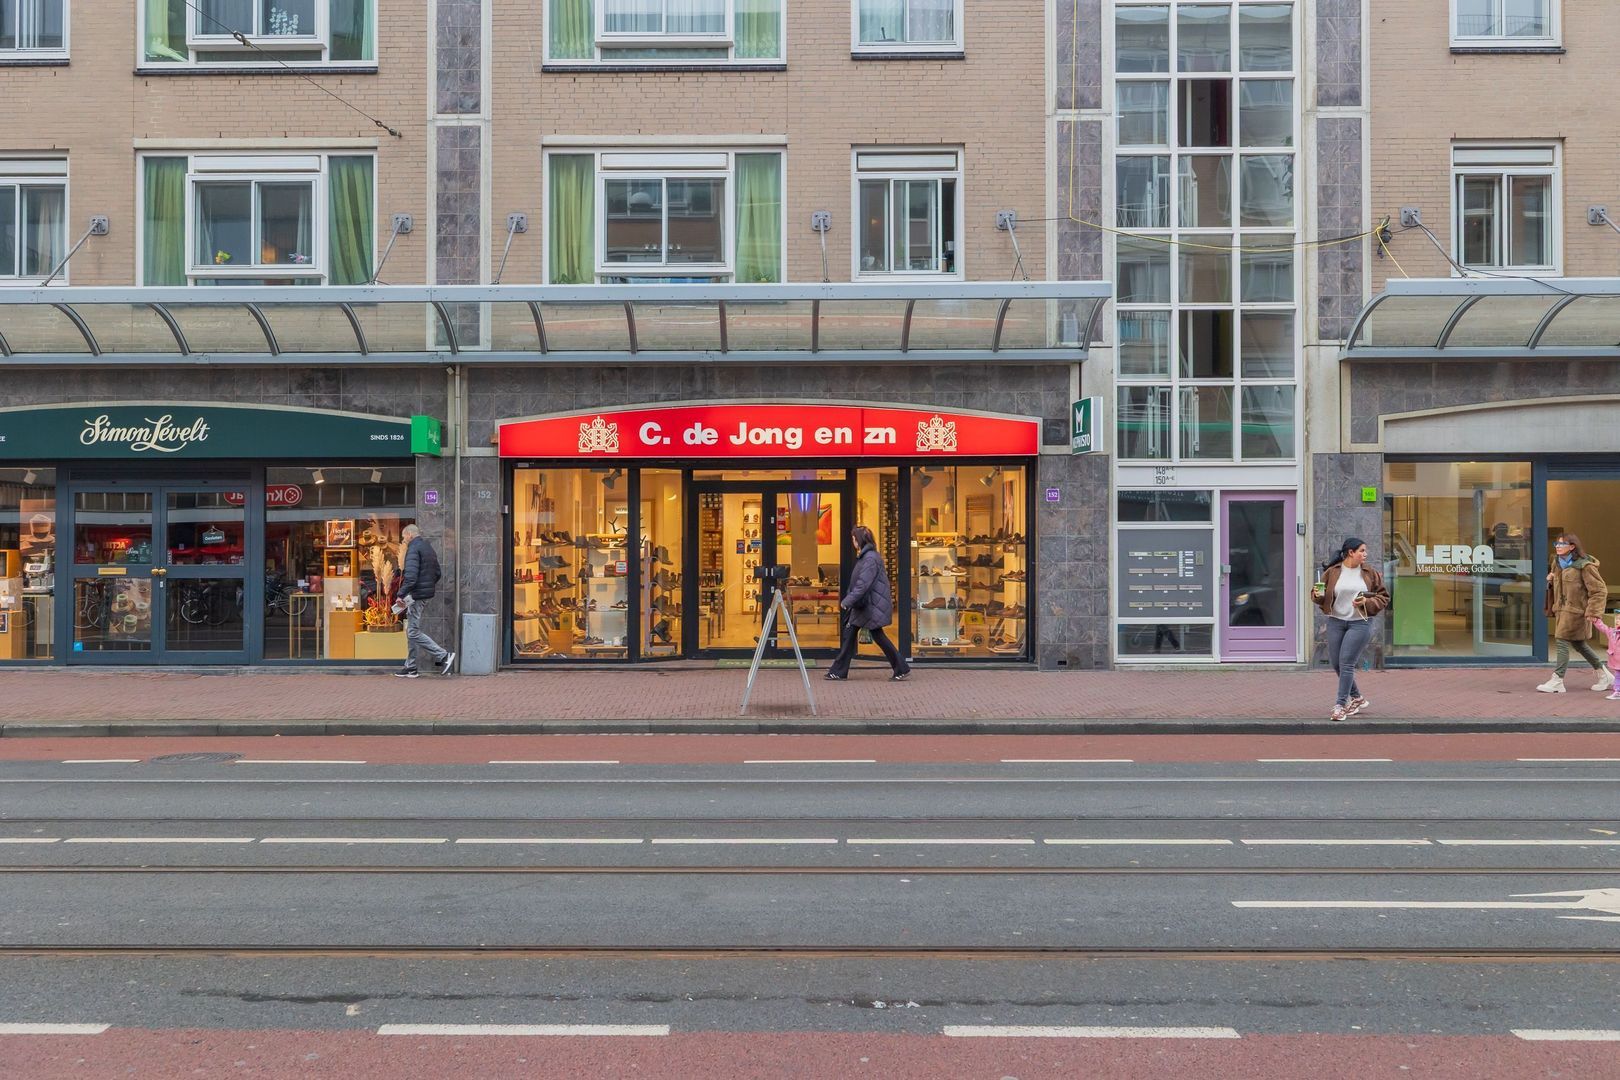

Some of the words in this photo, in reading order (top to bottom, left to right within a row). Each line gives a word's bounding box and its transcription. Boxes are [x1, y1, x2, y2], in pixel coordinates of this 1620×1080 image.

[80, 414, 152, 445] Simon
[131, 414, 211, 453] Lévelt
[639, 421, 671, 445] C.
[683, 422, 718, 445] de
[729, 422, 803, 450] Jong
[814, 427, 853, 445] en
[864, 427, 897, 444] zn
[477, 491, 492, 499] 152
[1416, 544, 1494, 564] LERA
[1416, 565, 1445, 573] Matcha,
[1446, 565, 1470, 573] Coffee,
[1471, 565, 1494, 573] Goods
